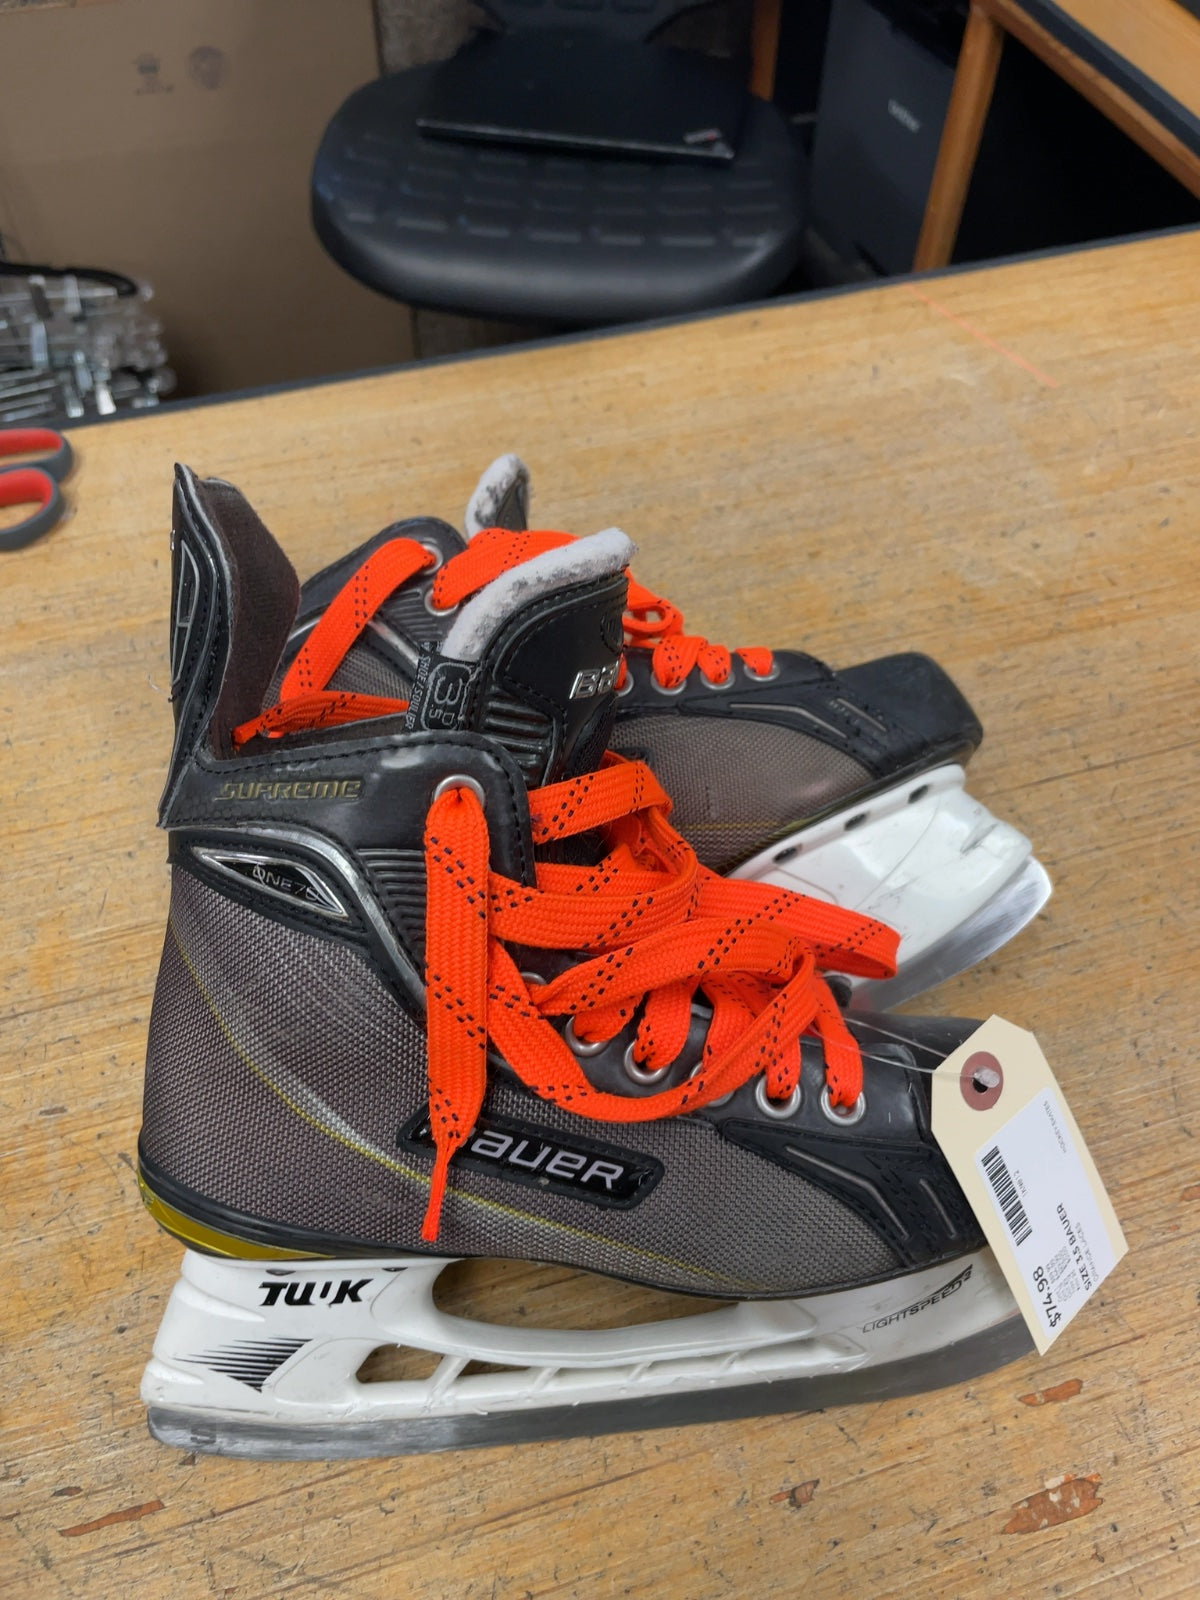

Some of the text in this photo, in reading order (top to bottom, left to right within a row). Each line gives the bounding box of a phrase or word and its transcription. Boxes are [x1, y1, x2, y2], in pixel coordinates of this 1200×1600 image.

[1057, 1202, 1092, 1291] SIZE 3.5 BAUER
[1032, 1265, 1062, 1328] $74.98
